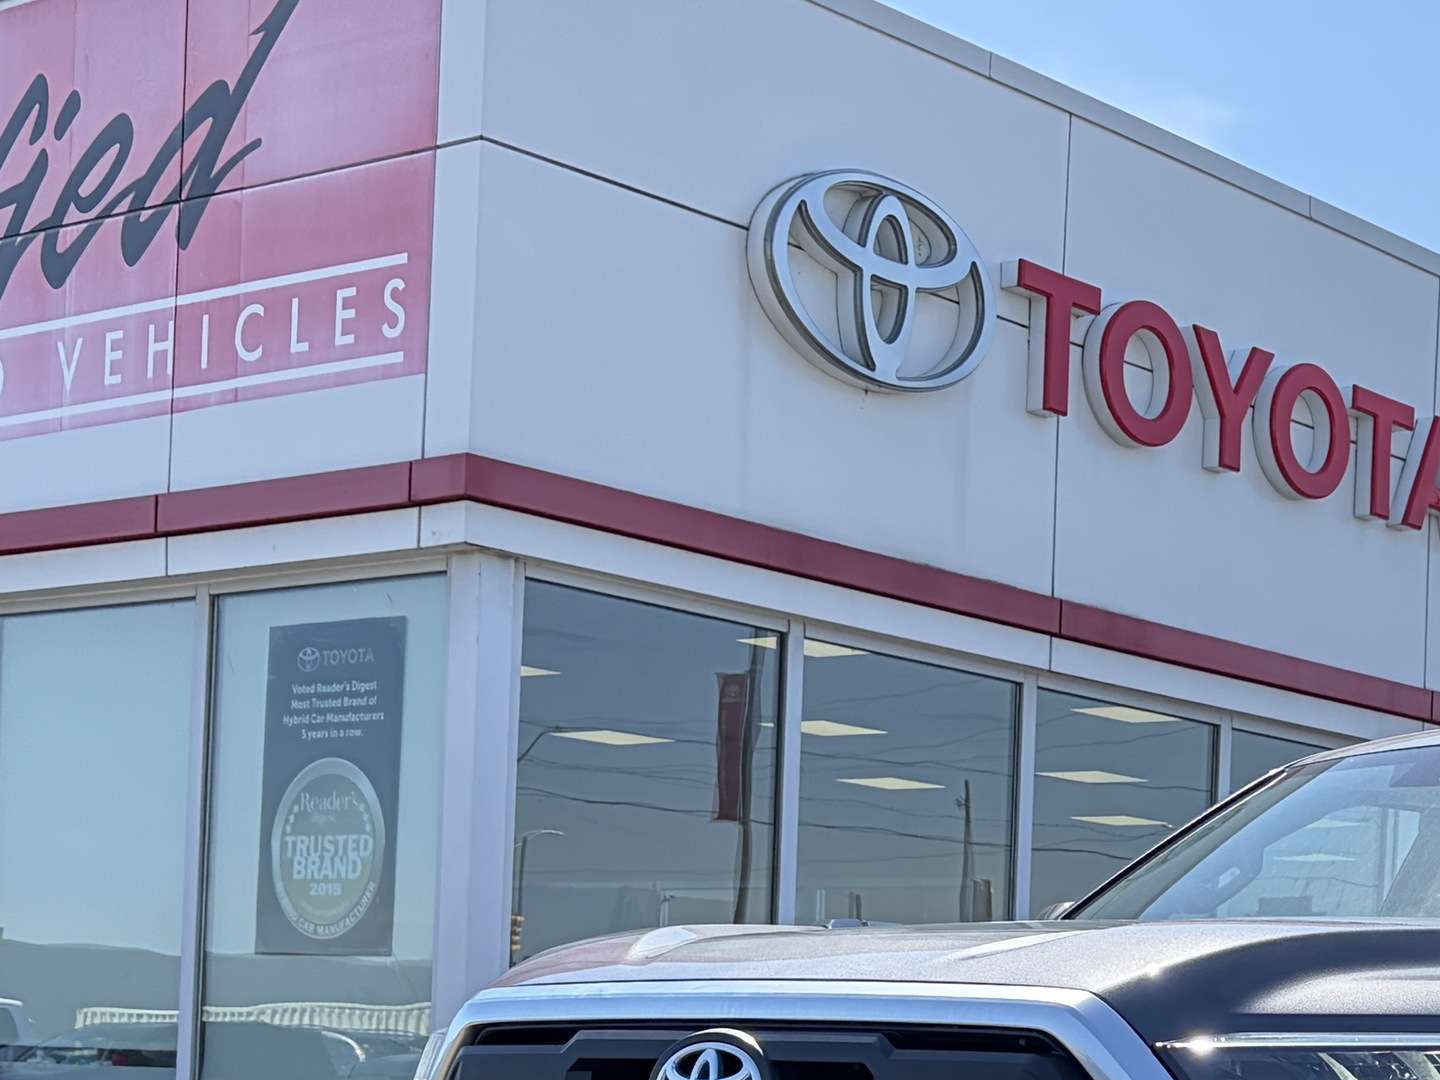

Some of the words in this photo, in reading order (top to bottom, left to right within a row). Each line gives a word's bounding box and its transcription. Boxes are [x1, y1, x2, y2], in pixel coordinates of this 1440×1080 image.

[57, 278, 406, 392] VEHICLES
[322, 648, 375, 665] TOYOTA
[291, 683, 315, 694] Voted
[317, 682, 350, 692] Reader's
[352, 680, 377, 693] Digest
[291, 698, 310, 709] Most
[312, 698, 341, 708] Trusted
[343, 696, 367, 707] Brand
[368, 695, 377, 705] of
[282, 714, 309, 727] Hybrid
[311, 713, 324, 724] Car
[326, 712, 384, 723] Manufacturers
[308, 730, 328, 741] years
[330, 729, 338, 738] in
[299, 791, 360, 813] Reader's
[285, 834, 373, 858] TRUSTED
[293, 855, 362, 881] BRAND
[308, 882, 343, 897] 2015
